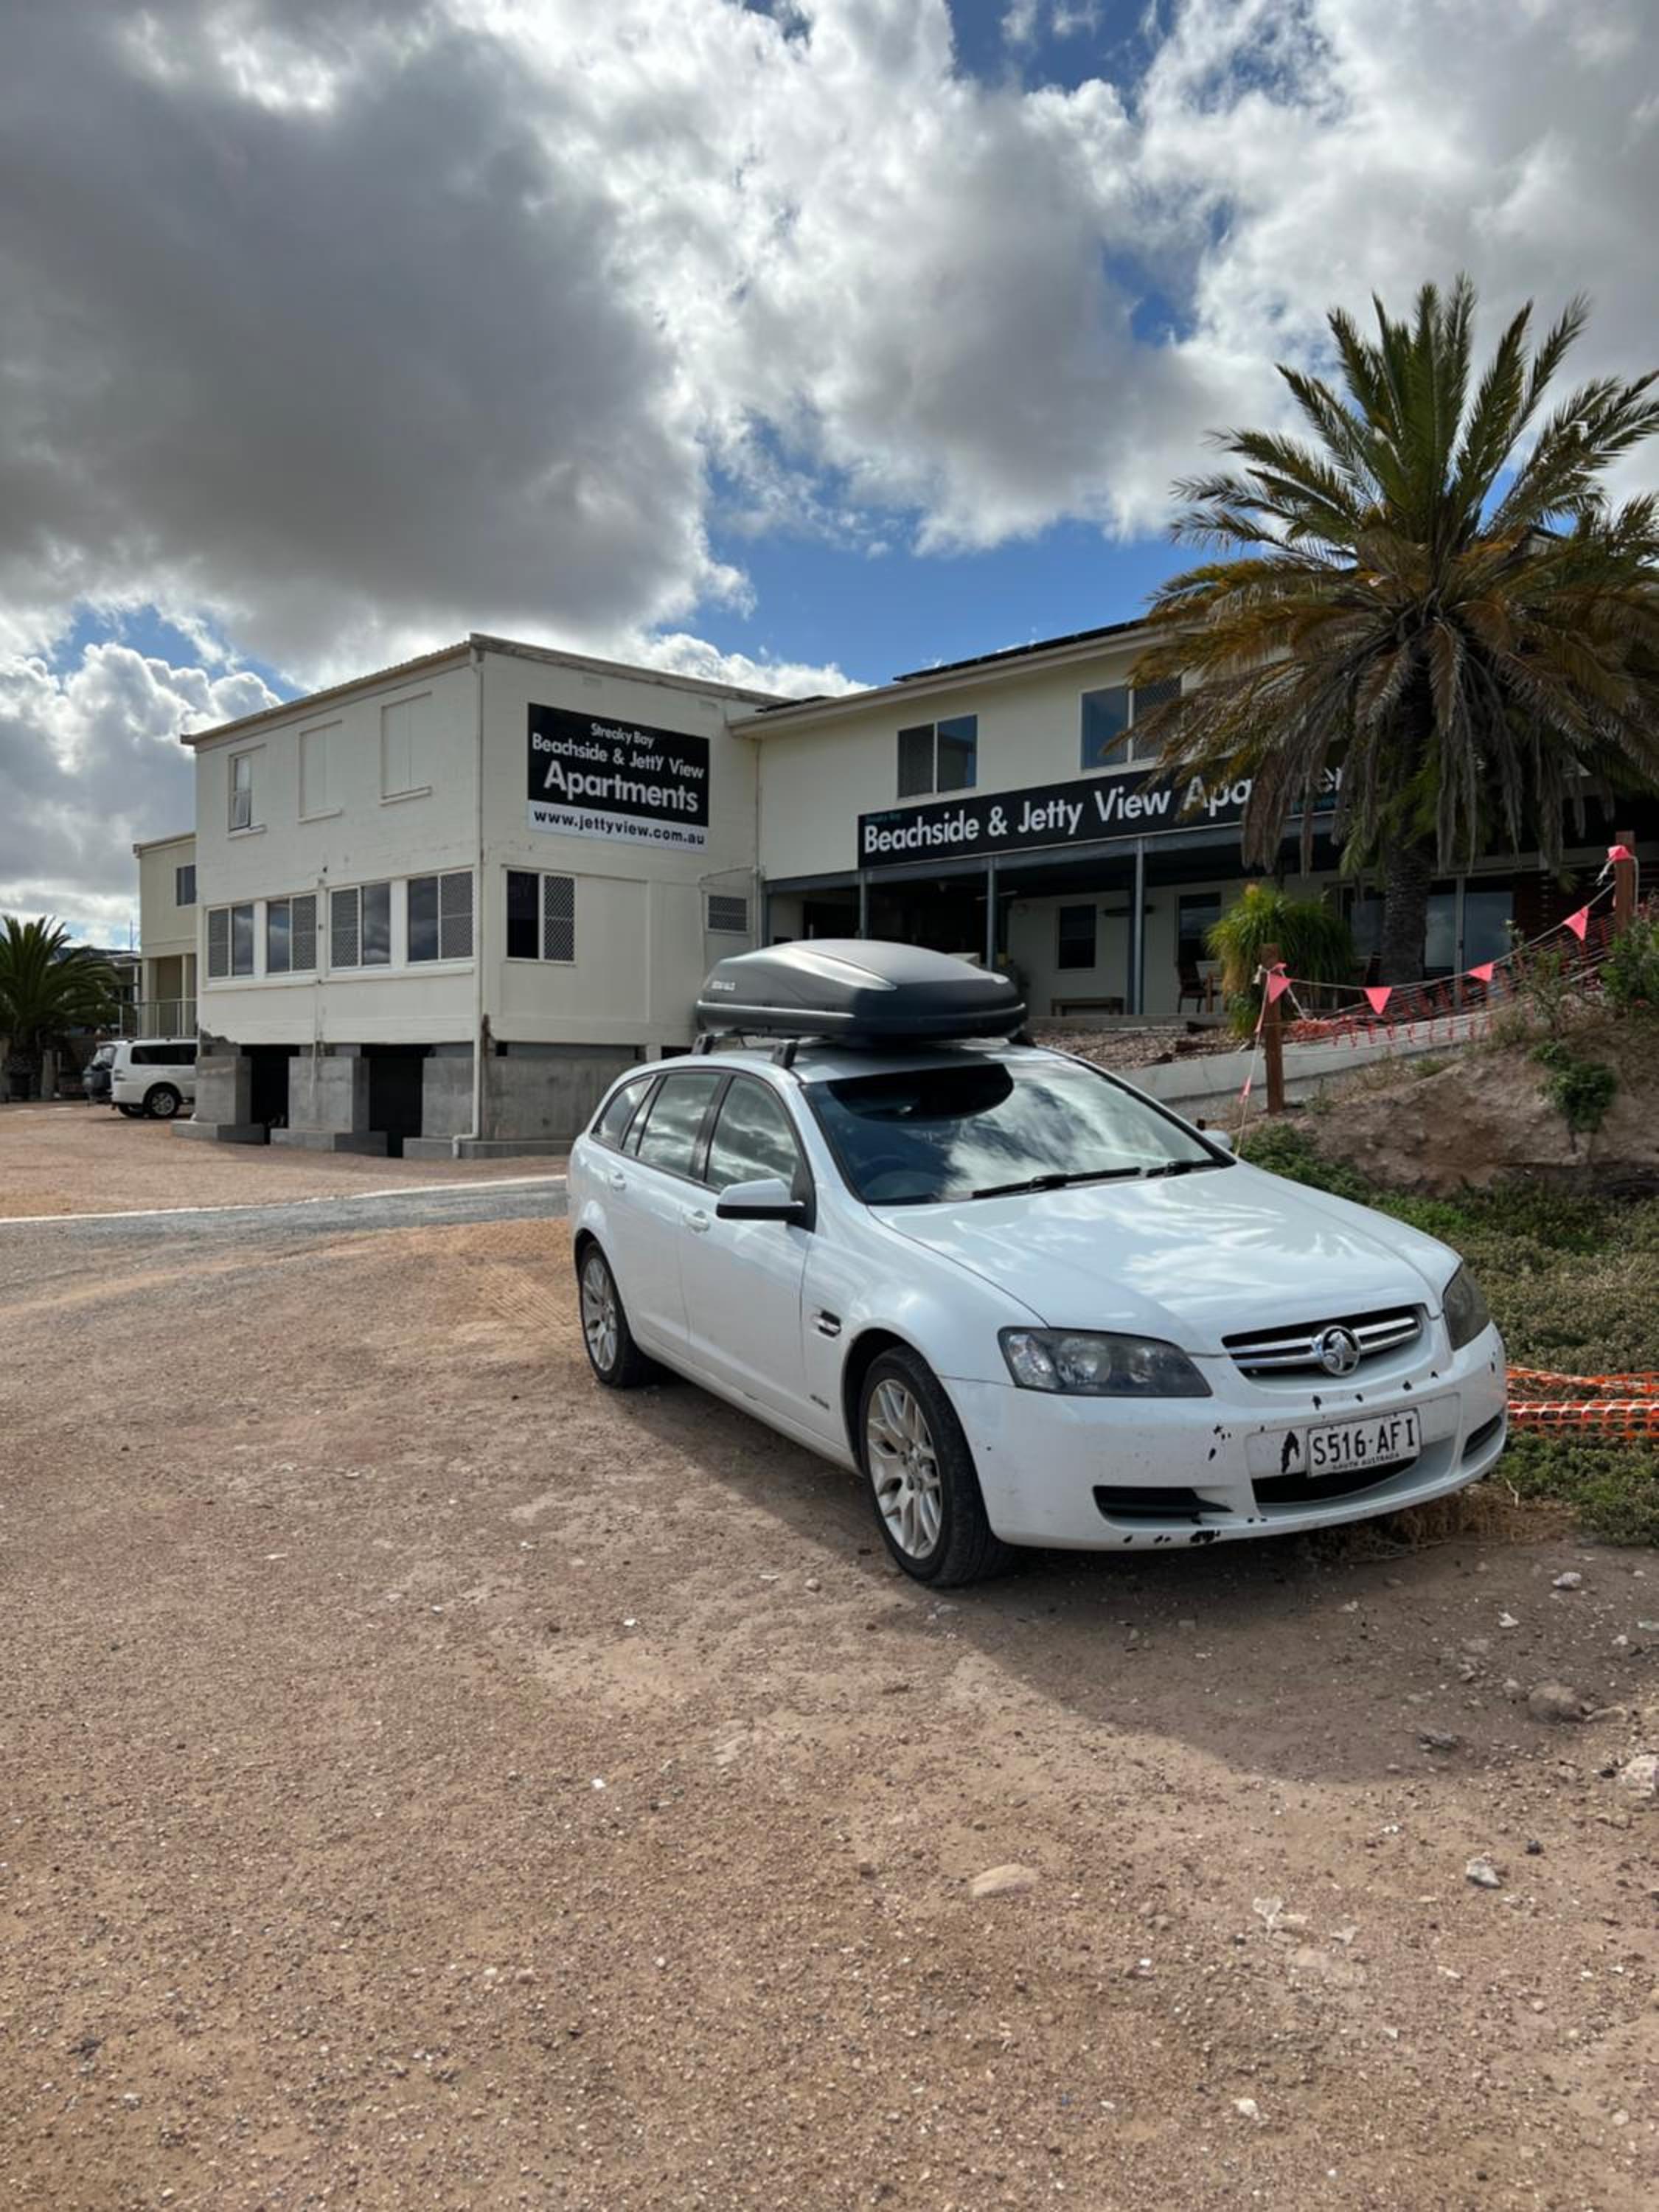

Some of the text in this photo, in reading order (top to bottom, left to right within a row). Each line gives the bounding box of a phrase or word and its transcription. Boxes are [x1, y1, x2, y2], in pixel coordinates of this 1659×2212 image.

[532, 732, 705, 779] Beachside & Jetty View
[591, 723, 655, 749] Streaky Bay
[543, 759, 699, 813] Apartments
[533, 810, 705, 845] www.jettyview.com.au
[864, 810, 980, 854] Beachside
[987, 806, 1008, 837] &
[1018, 799, 1084, 835] Jetty
[1093, 785, 1172, 822] View
